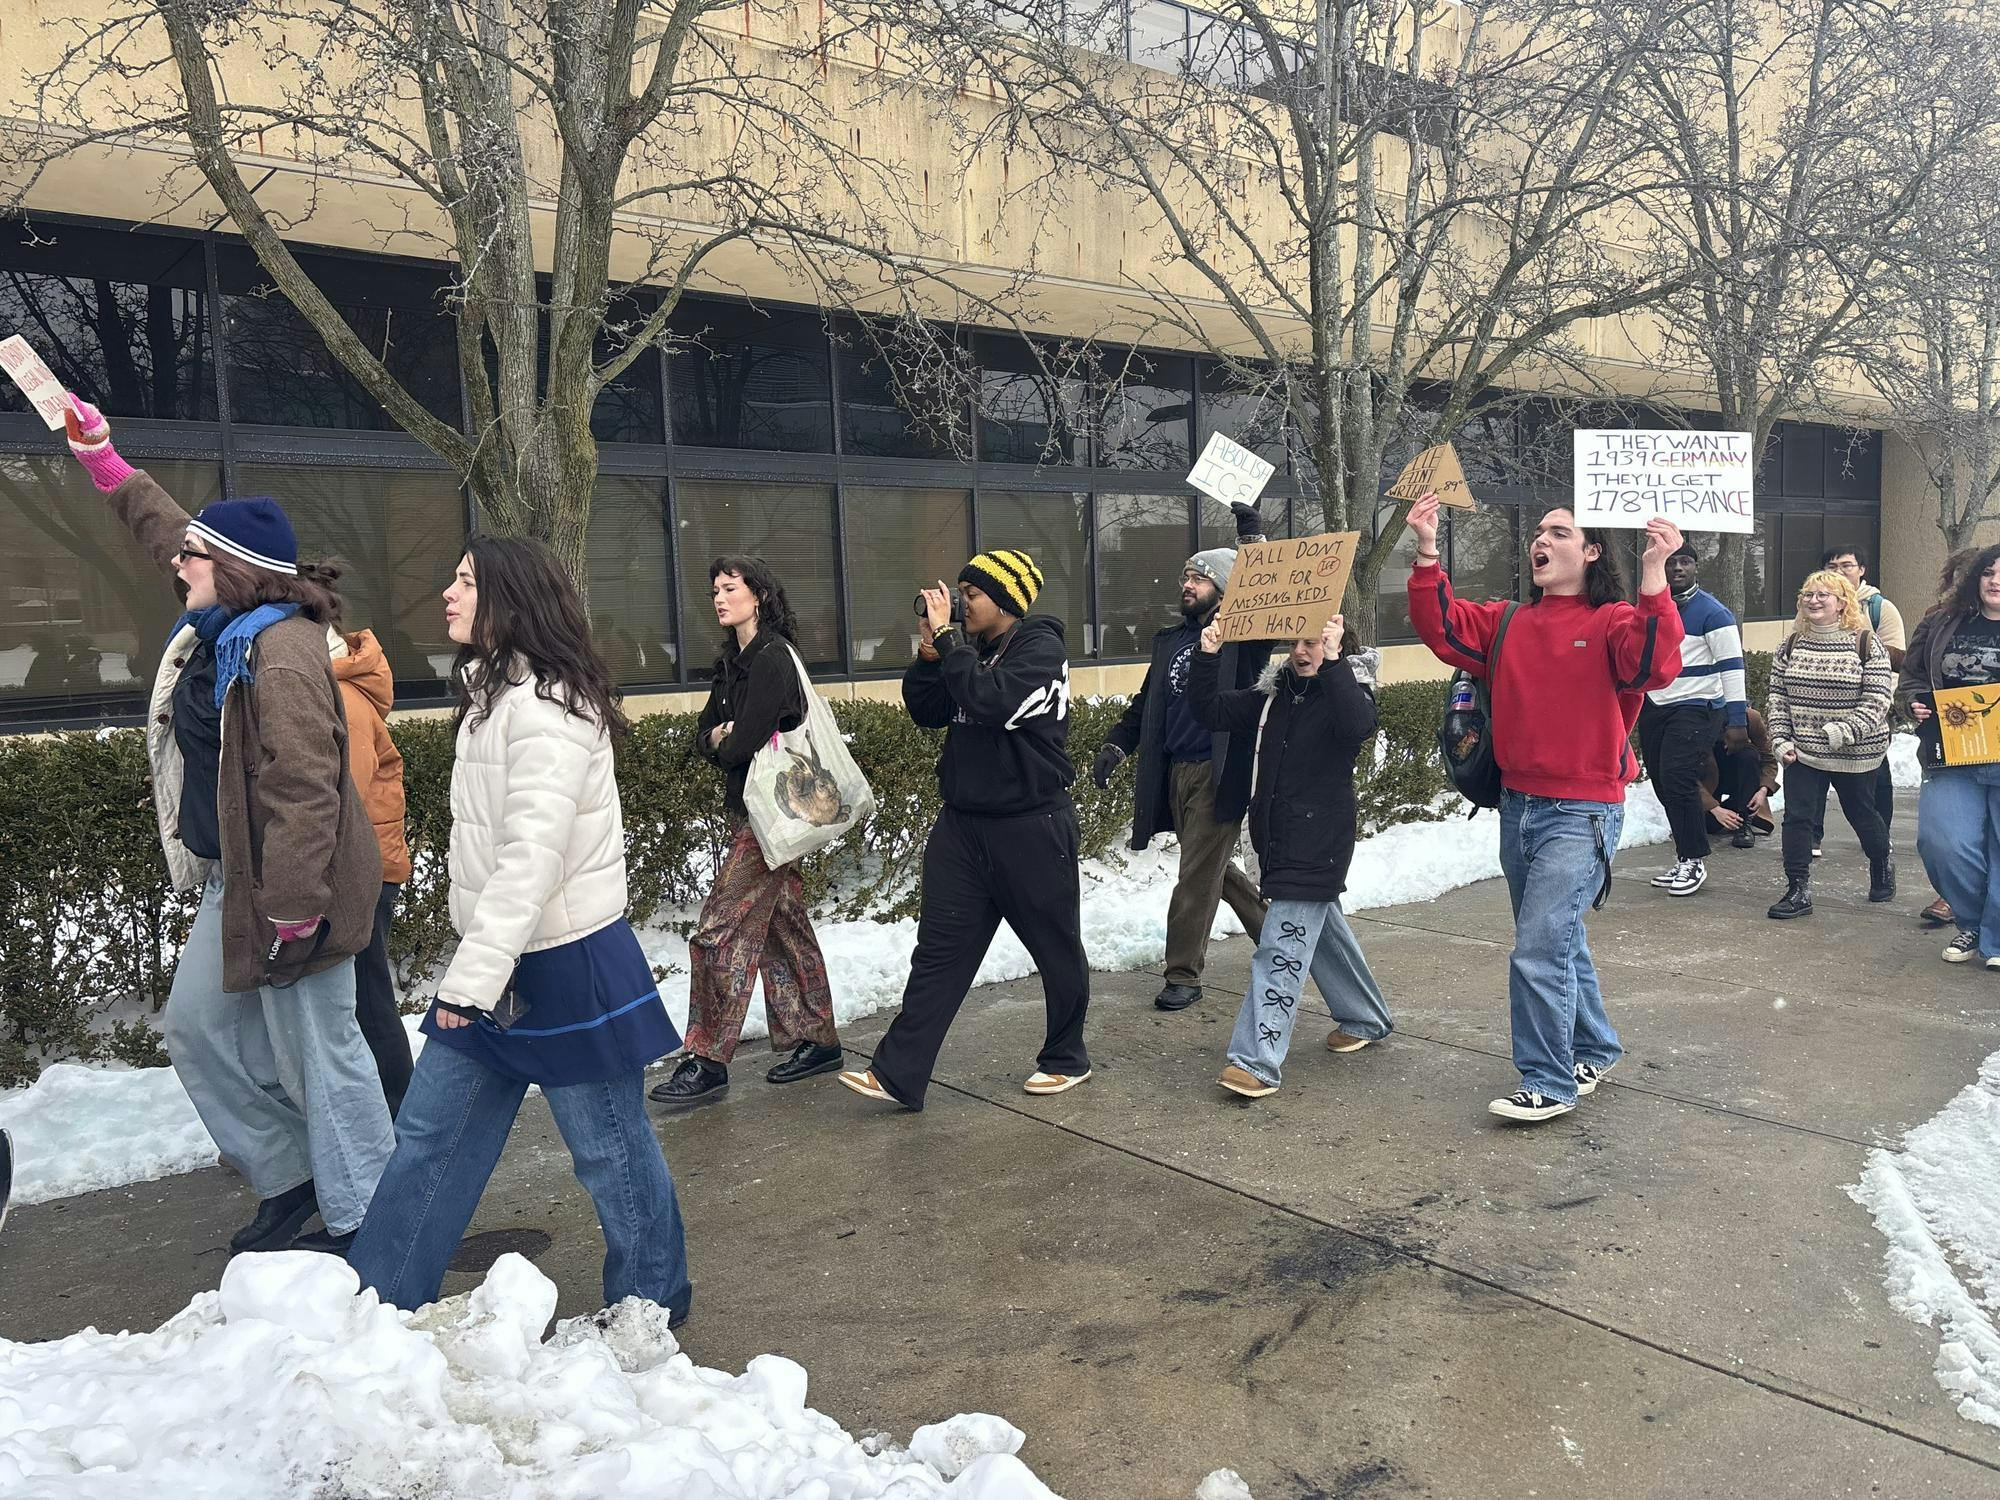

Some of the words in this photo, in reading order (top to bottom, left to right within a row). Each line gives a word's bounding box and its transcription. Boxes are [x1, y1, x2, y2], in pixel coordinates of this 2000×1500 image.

[1596, 434, 1663, 450] THEY
[1666, 435, 1740, 451] WANT
[1211, 435, 1272, 483] ABOLISH
[1587, 450, 1648, 467] 1939
[1652, 451, 1748, 468] GERMANY
[1586, 473, 1667, 487] THEY'LL
[1672, 474, 1723, 487] GET
[1587, 490, 1659, 513] 1789
[1662, 489, 1752, 516] FRANCE
[1244, 547, 1284, 568] Y'ALL
[1238, 572, 1278, 588] LOOK
[1288, 569, 1312, 586] FOR
[1228, 591, 1290, 613] MISSING
[1296, 585, 1329, 603] KIDS
[1222, 614, 1255, 639] THIS
[1265, 613, 1307, 635] HARD
